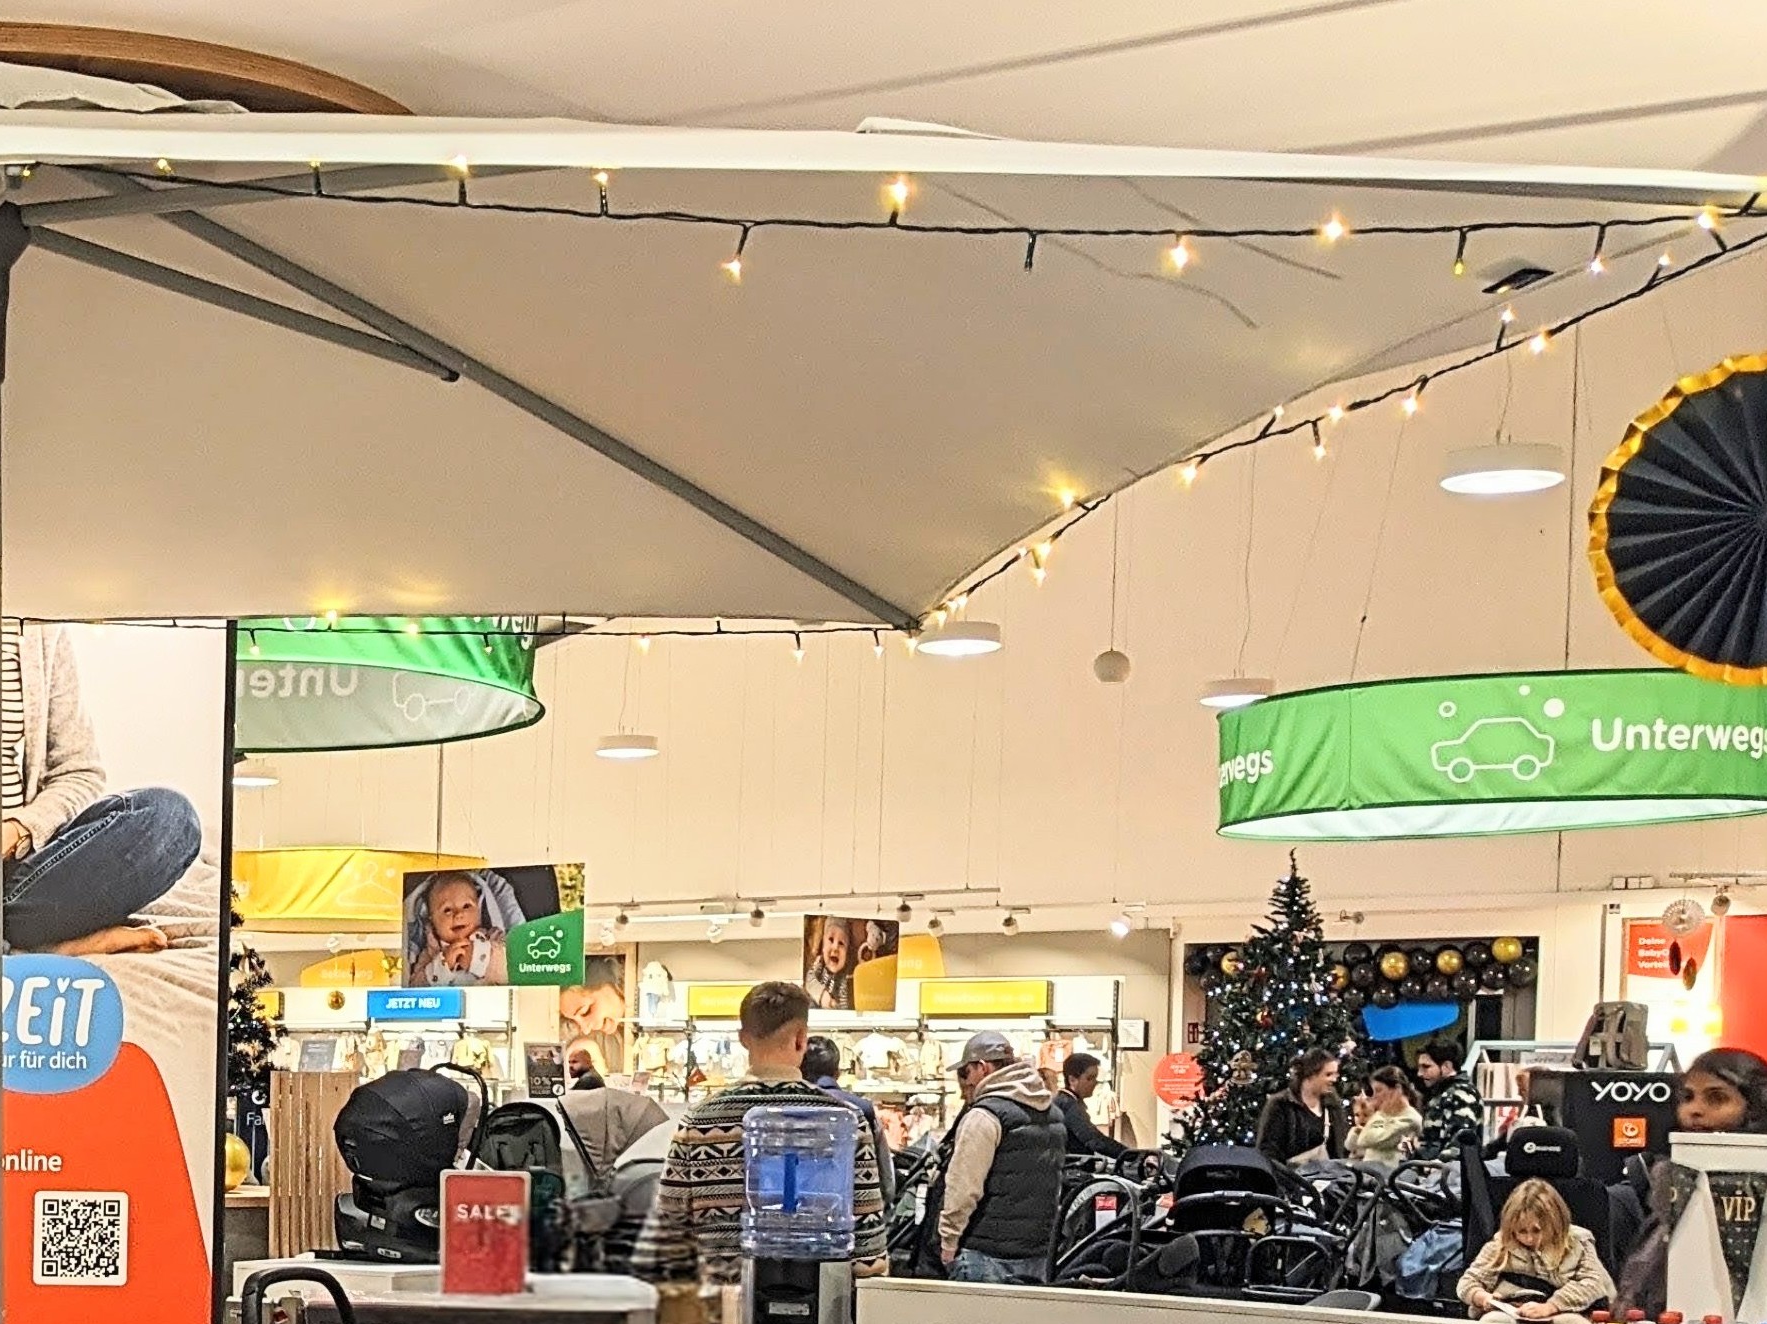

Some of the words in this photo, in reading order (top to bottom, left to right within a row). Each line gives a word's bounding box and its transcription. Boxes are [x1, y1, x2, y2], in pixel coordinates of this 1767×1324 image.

[1592, 717, 1767, 760] Unterweg
[519, 963, 571, 973] Unterwegs
[386, 998, 417, 1009] JETZT
[419, 998, 441, 1008] NEU
[2, 1055, 16, 1068] ur
[20, 1051, 45, 1068] für
[49, 1051, 87, 1069] dich
[1591, 1081, 1671, 1102] YOYO
[1, 1149, 62, 1171] nline
[1722, 1196, 1756, 1221] VIP
